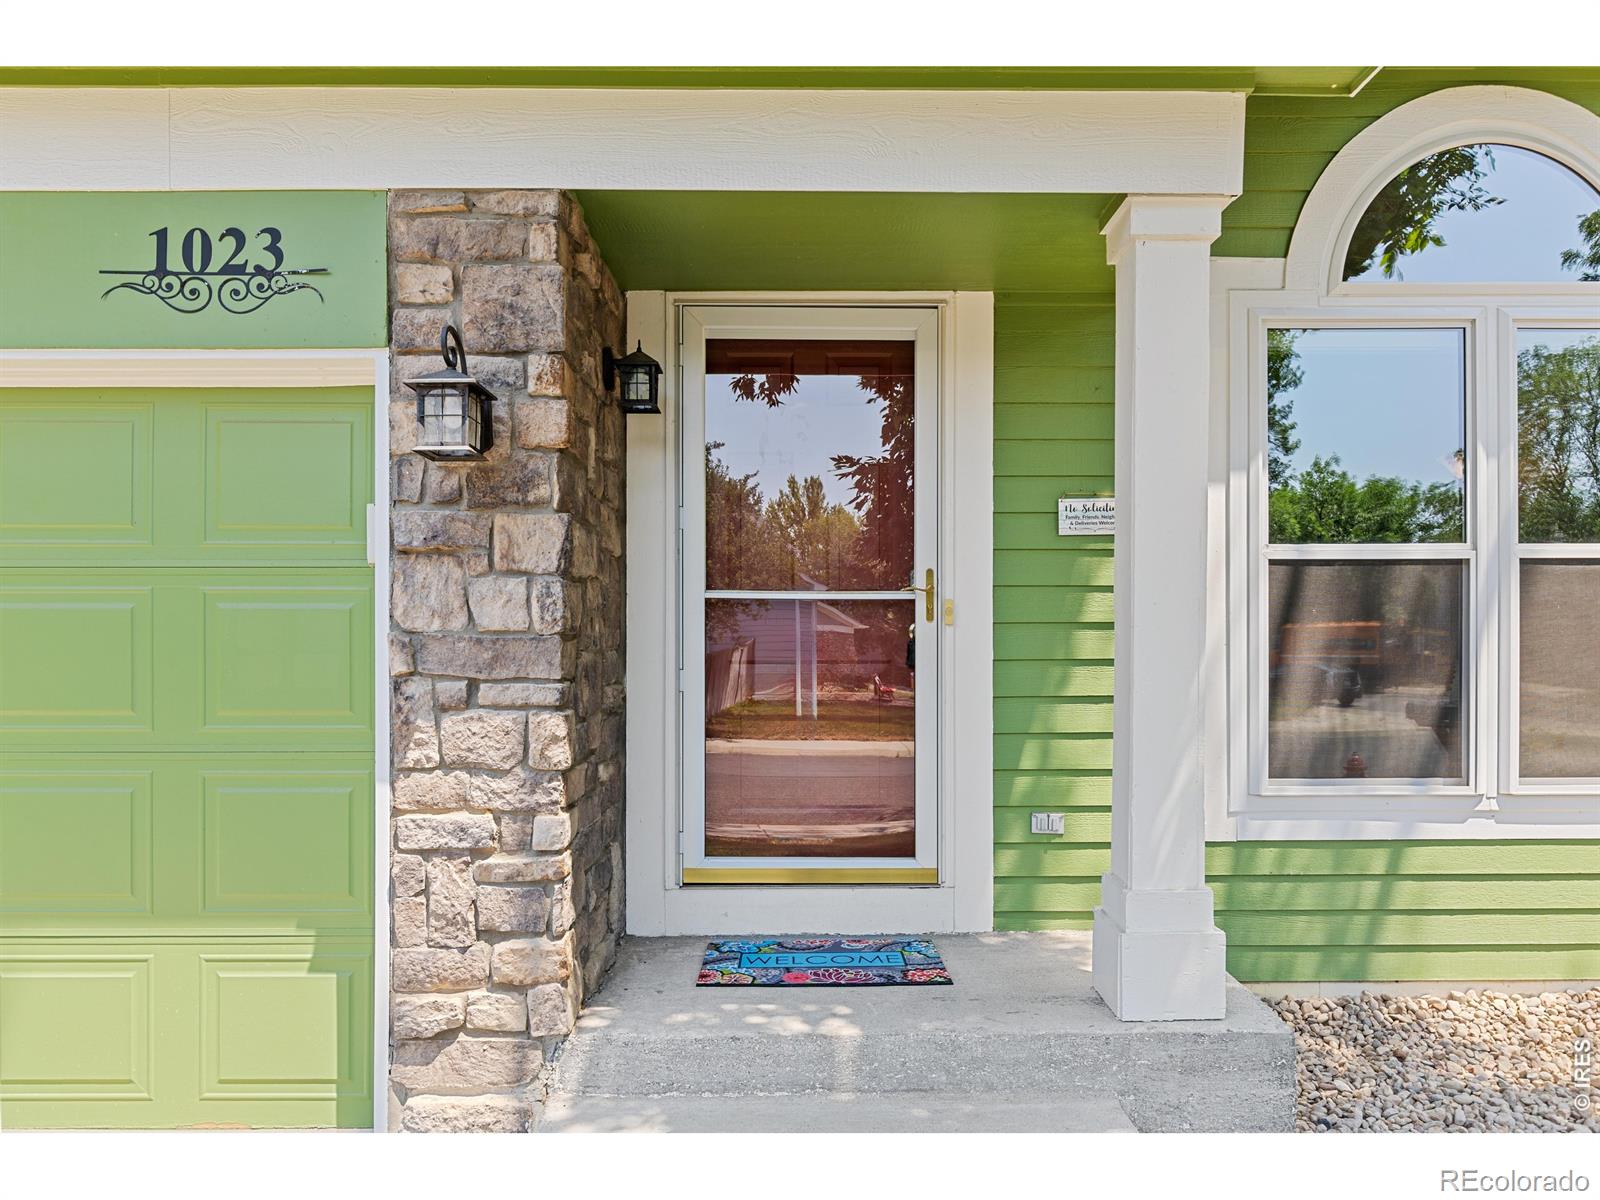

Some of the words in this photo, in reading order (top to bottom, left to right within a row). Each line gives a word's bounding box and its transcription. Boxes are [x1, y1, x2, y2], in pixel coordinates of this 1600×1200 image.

[149, 227, 284, 274] 1023
[1064, 504, 1078, 513] No
[746, 954, 900, 965] WELCOME
